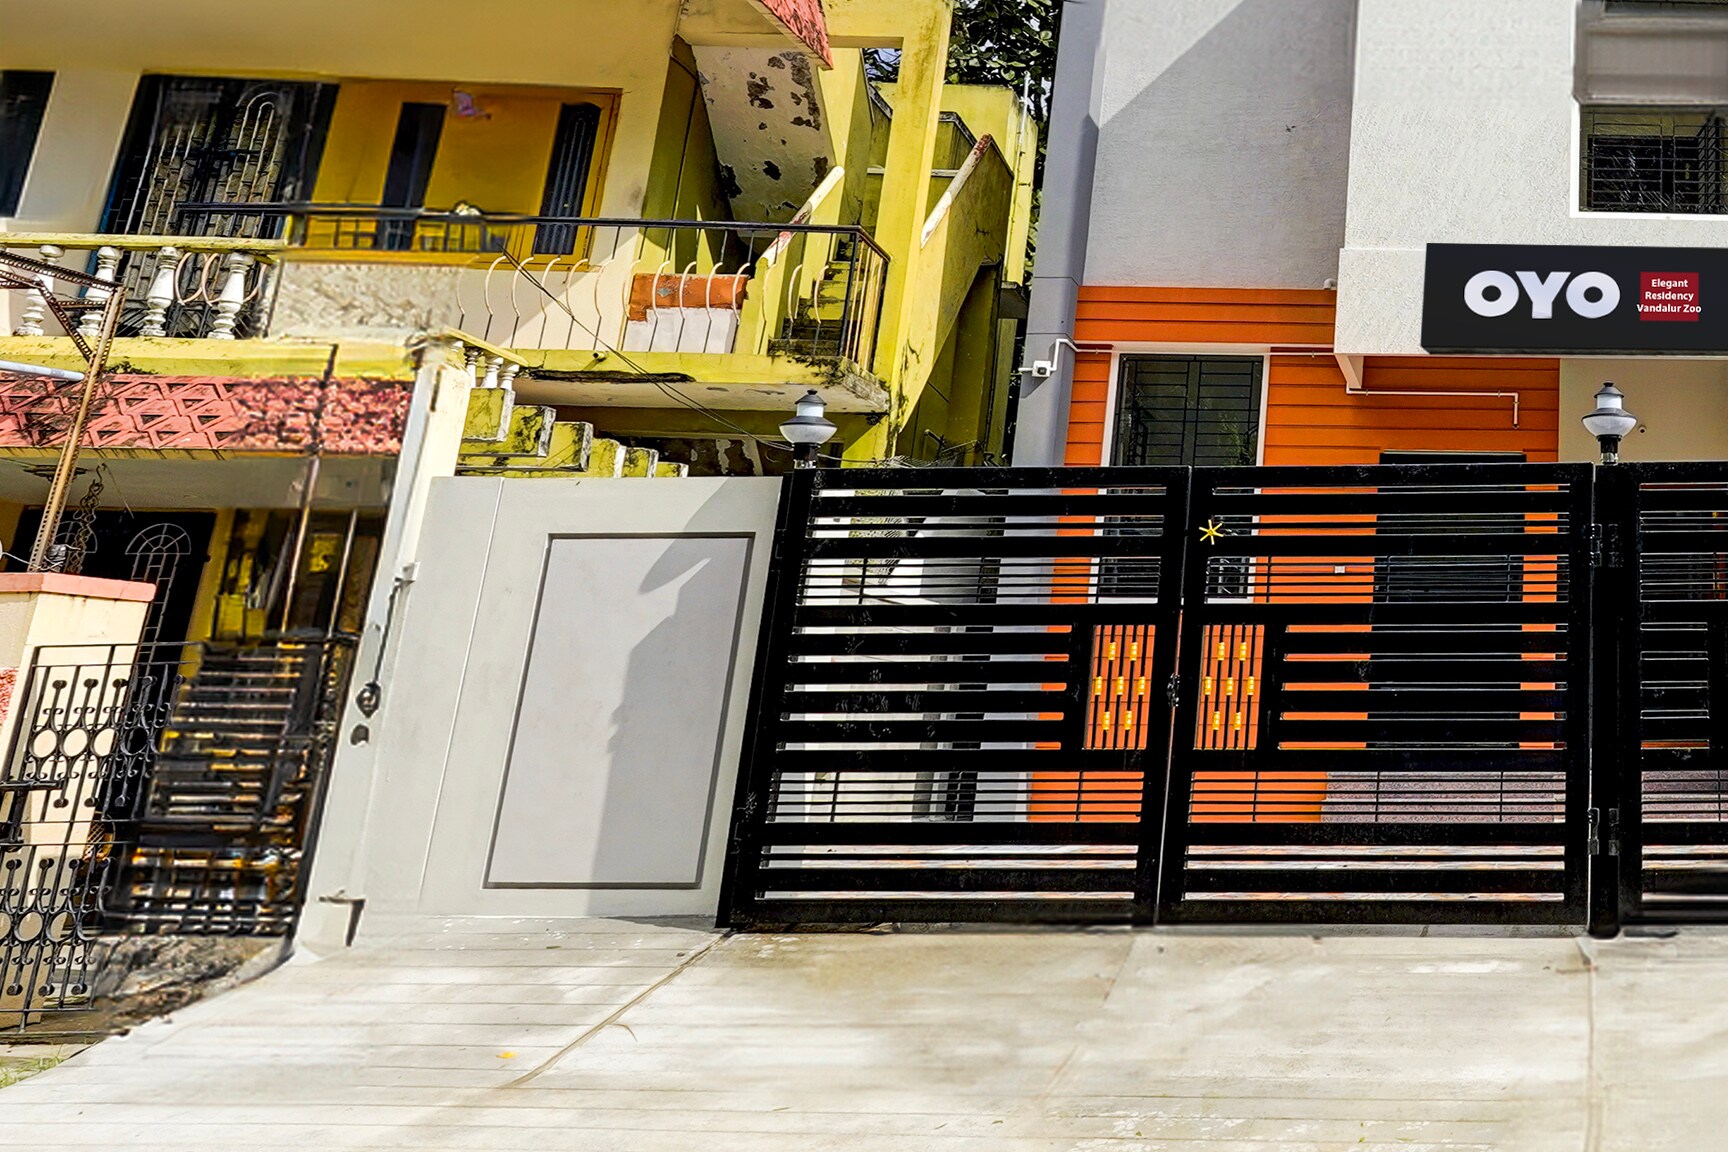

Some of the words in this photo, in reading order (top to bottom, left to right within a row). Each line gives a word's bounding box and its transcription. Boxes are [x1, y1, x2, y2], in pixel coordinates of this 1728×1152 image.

[1651, 278, 1689, 290] Elegant
[1464, 270, 1621, 319] OYO
[1645, 291, 1694, 302] Residency
[1636, 303, 1681, 313] Vandalur
[1683, 304, 1702, 313] Zoo
